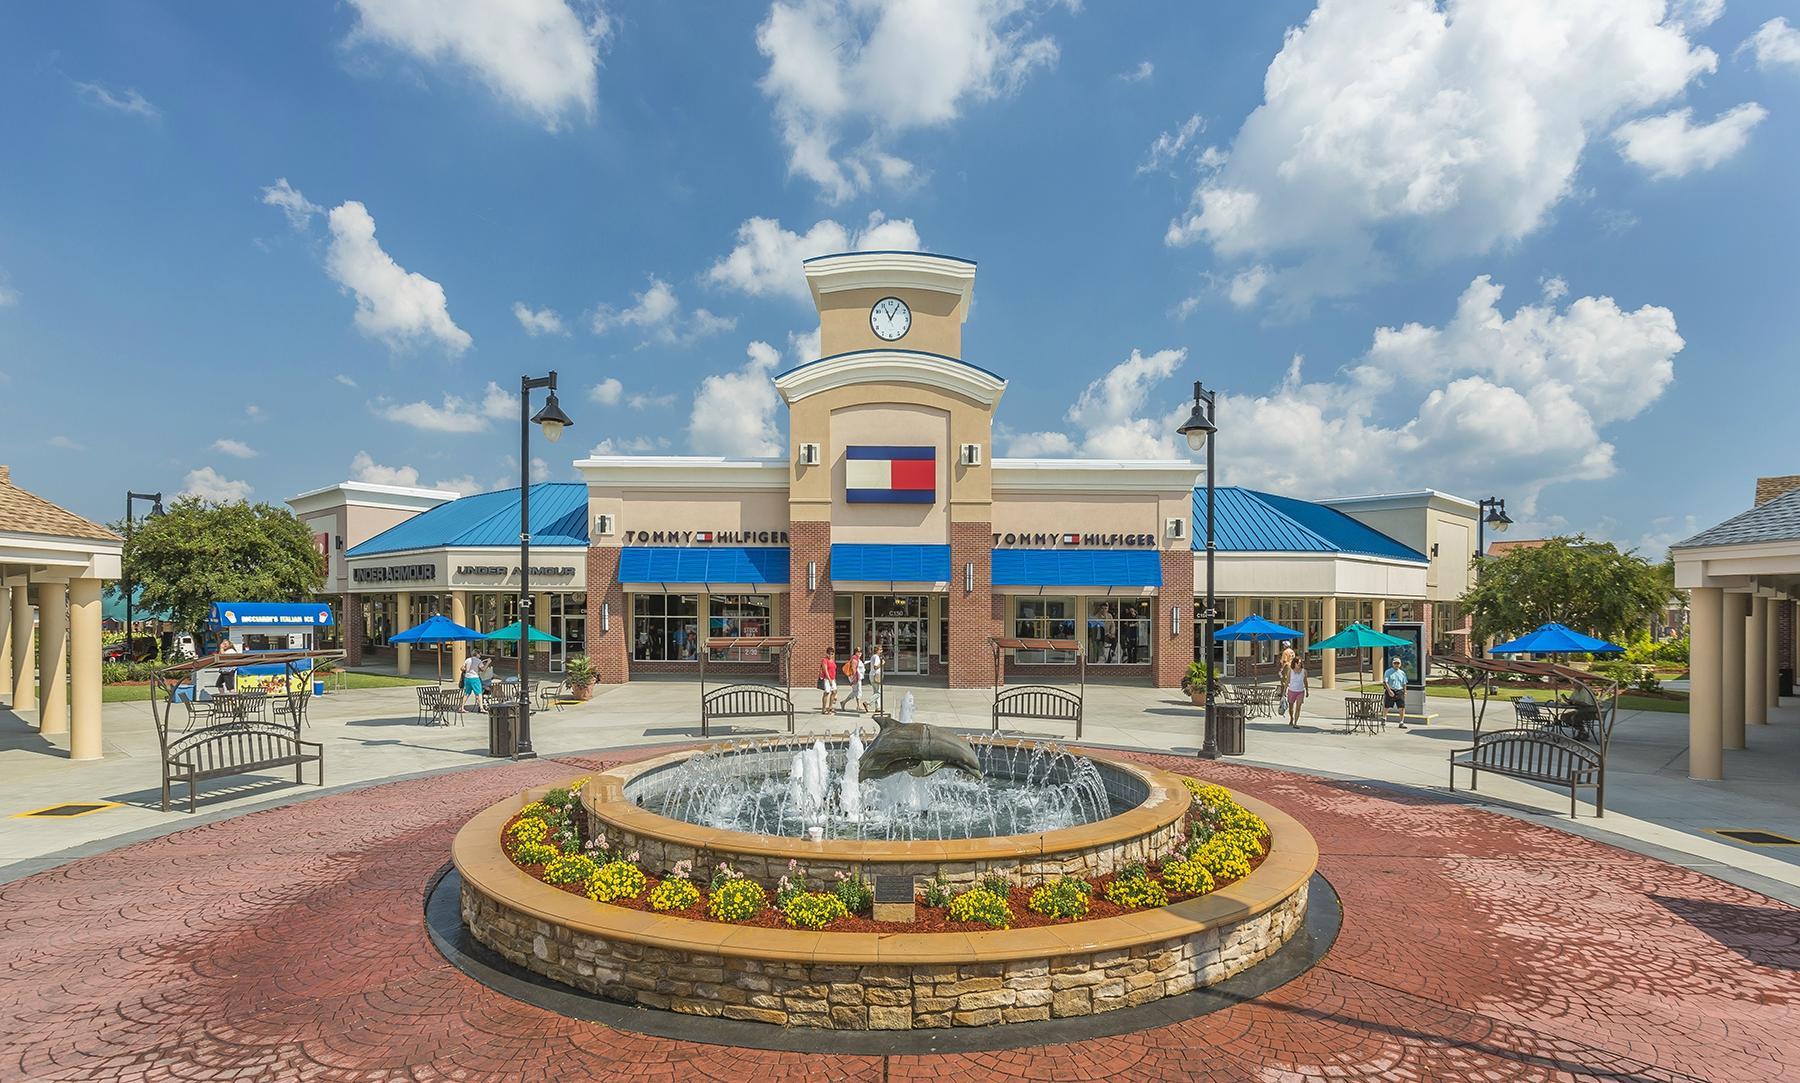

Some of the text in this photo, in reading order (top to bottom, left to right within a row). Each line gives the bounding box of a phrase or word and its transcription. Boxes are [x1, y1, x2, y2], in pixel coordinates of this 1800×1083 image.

[626, 530, 790, 544] TOMMY HILFIGER
[992, 532, 1156, 546] TOMMY HILFIGER
[353, 564, 436, 582] UNDER ARMOUR
[457, 565, 508, 576] UNDER
